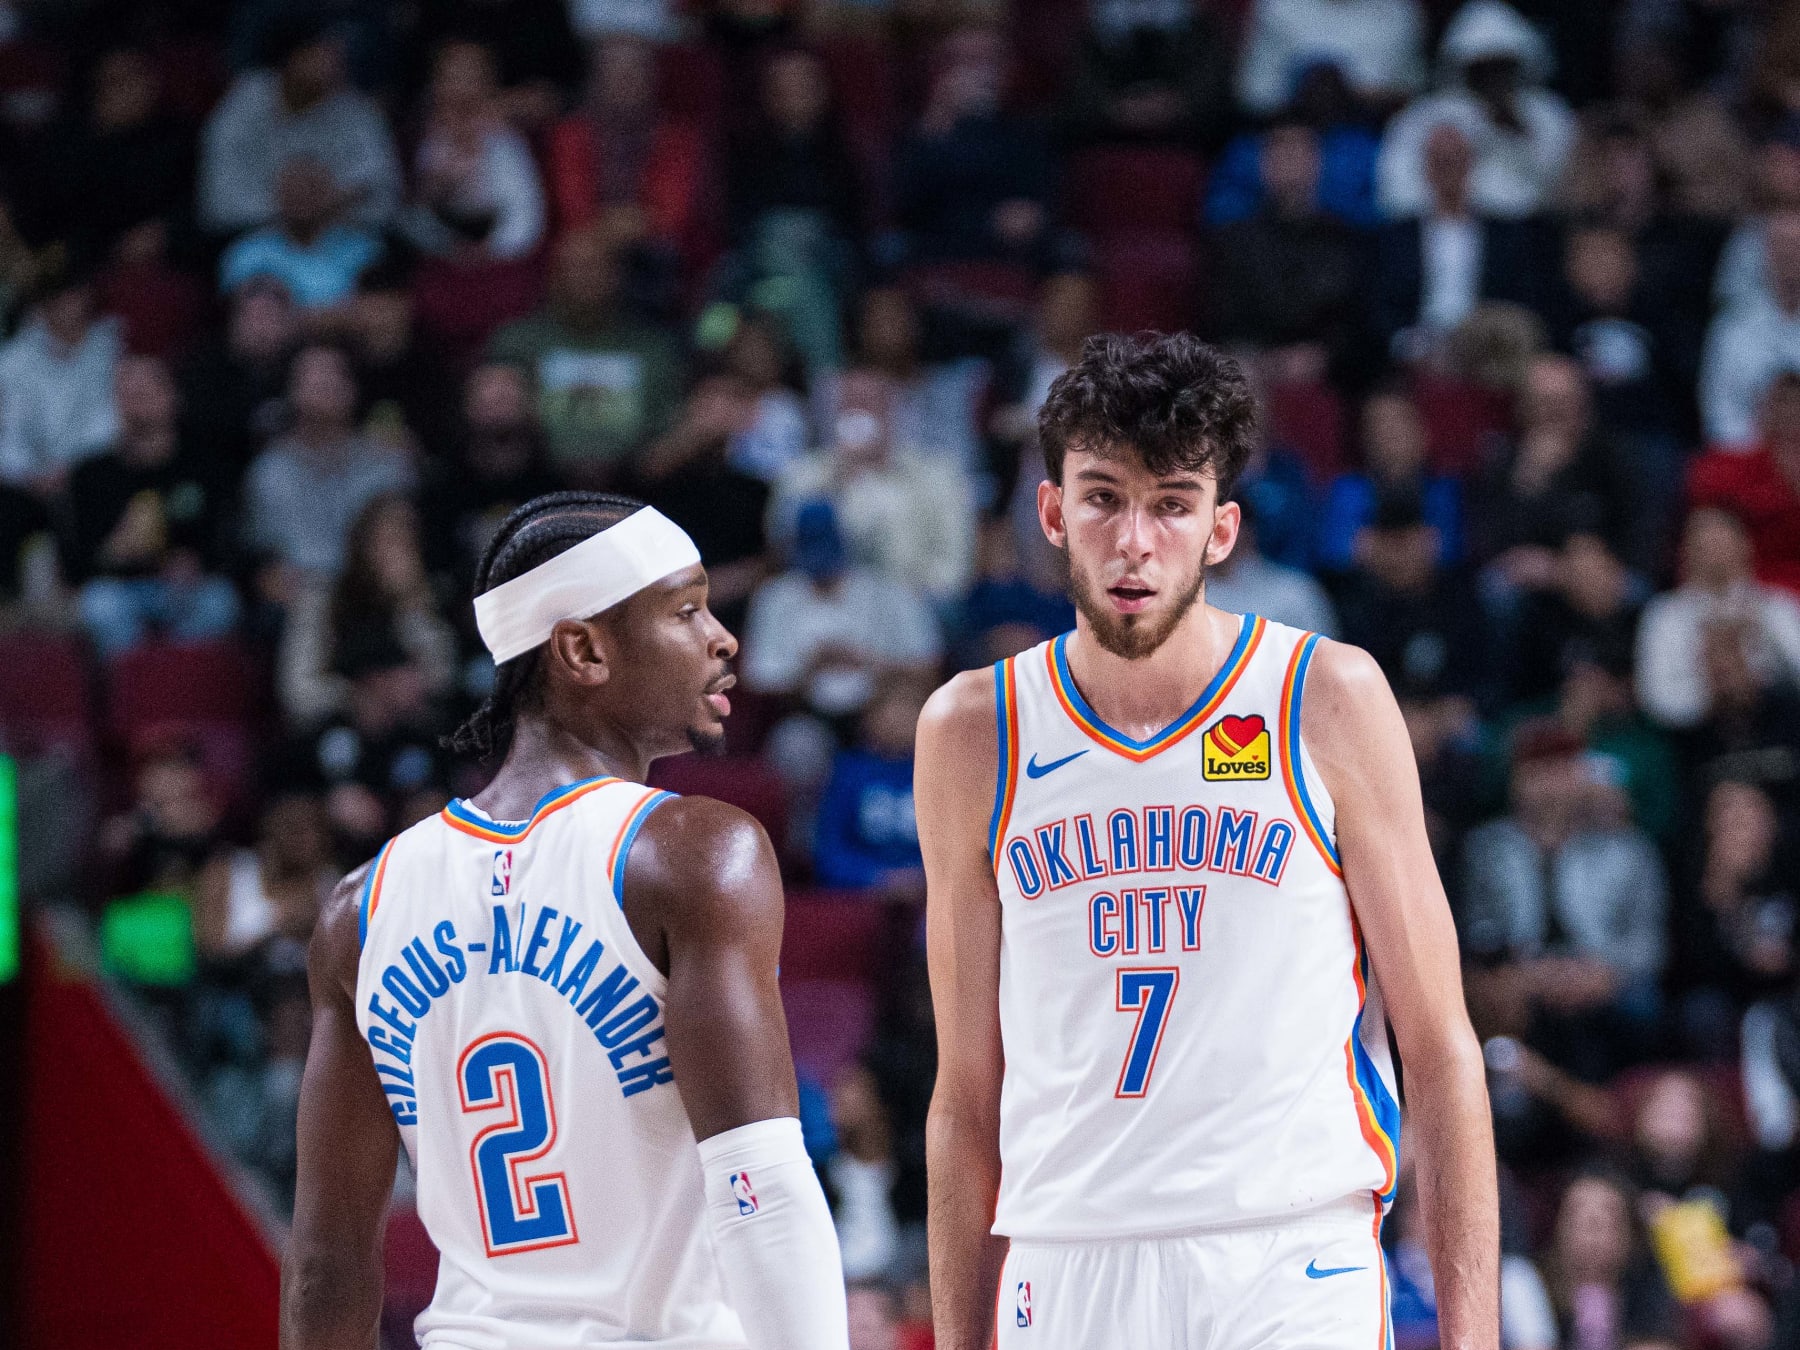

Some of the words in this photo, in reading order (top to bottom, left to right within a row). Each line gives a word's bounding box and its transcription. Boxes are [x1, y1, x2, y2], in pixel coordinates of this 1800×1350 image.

[1007, 805, 1296, 900] OKLAHOMA
[1089, 884, 1207, 957] CITY
[1114, 966, 1180, 1099] 7
[456, 1030, 580, 1259] 2
